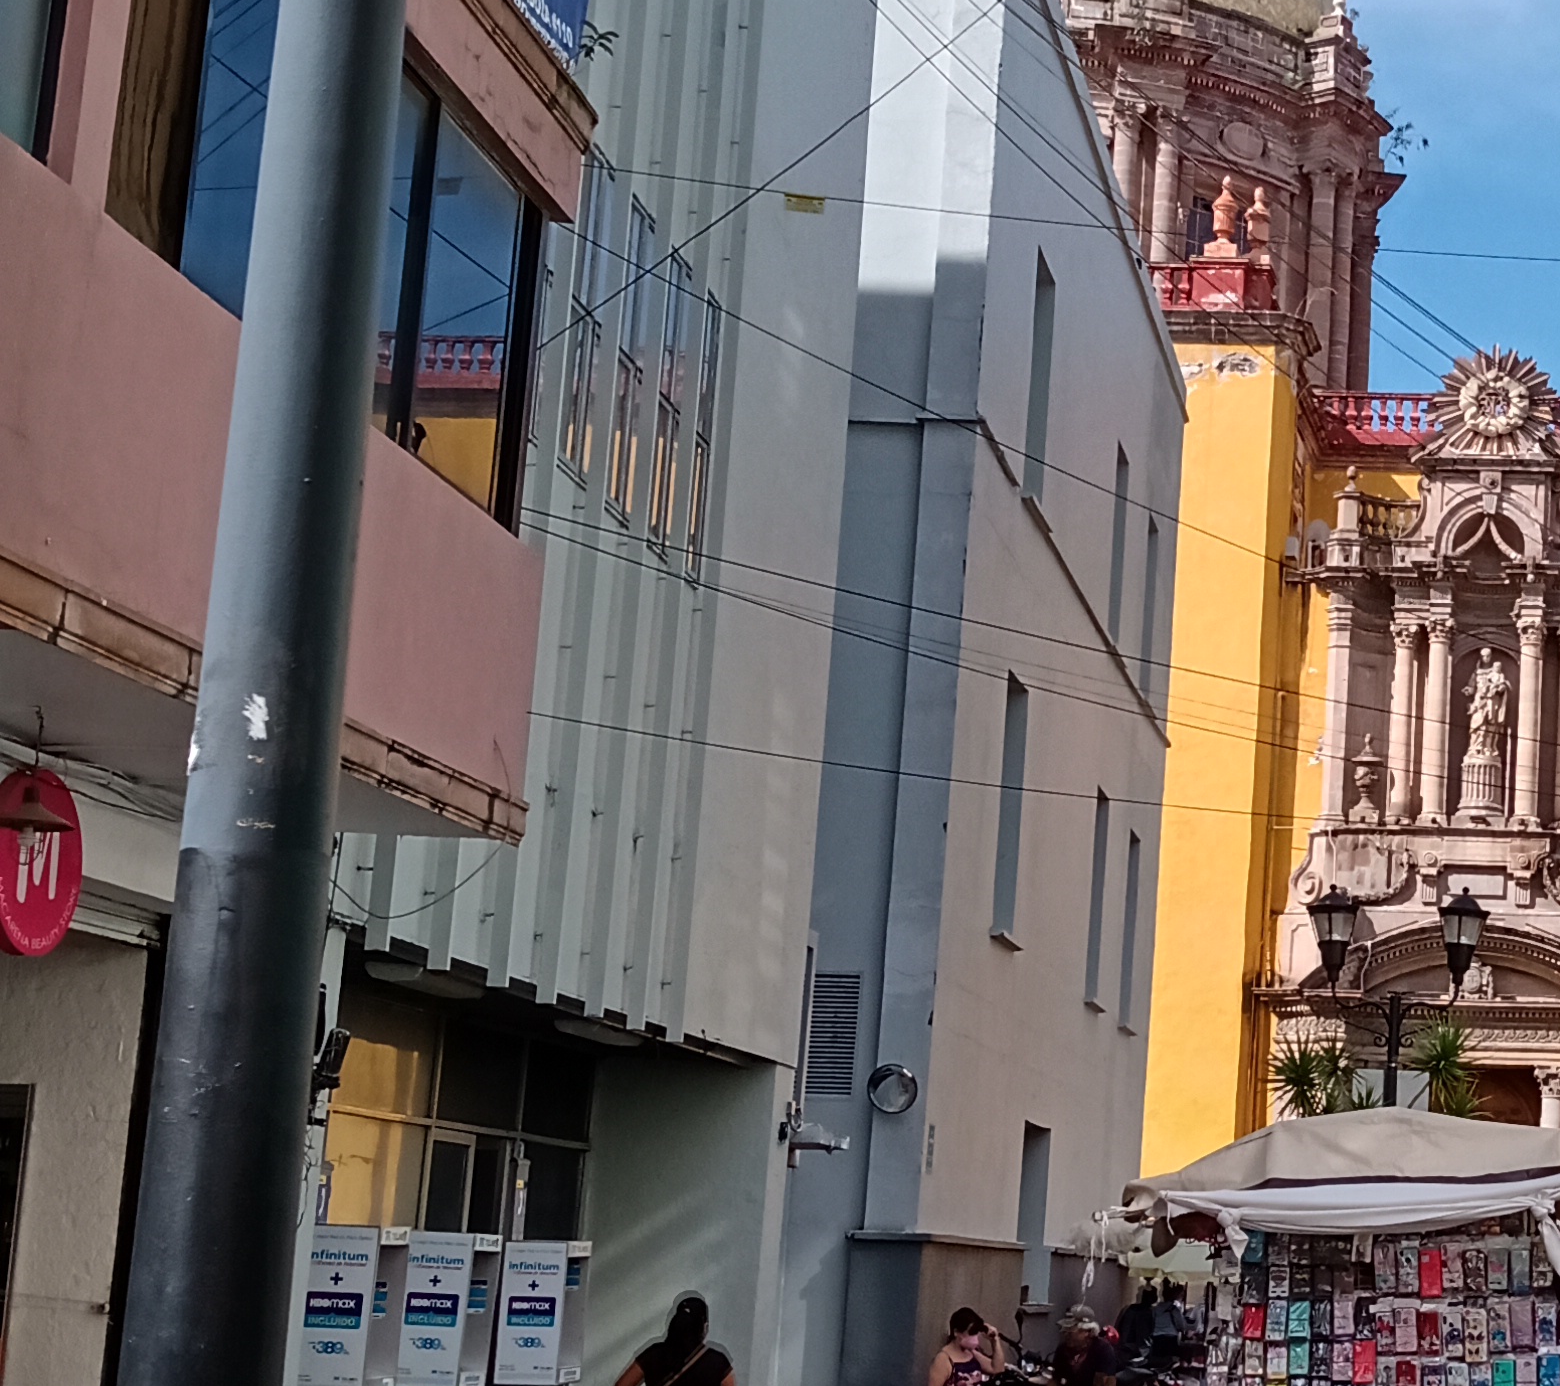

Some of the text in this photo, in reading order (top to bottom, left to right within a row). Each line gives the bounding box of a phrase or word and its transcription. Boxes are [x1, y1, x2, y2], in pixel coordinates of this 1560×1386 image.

[311, 1249, 369, 1262] nfinitum
[408, 1253, 465, 1266] infinitum
[508, 1260, 560, 1271] infinitum
